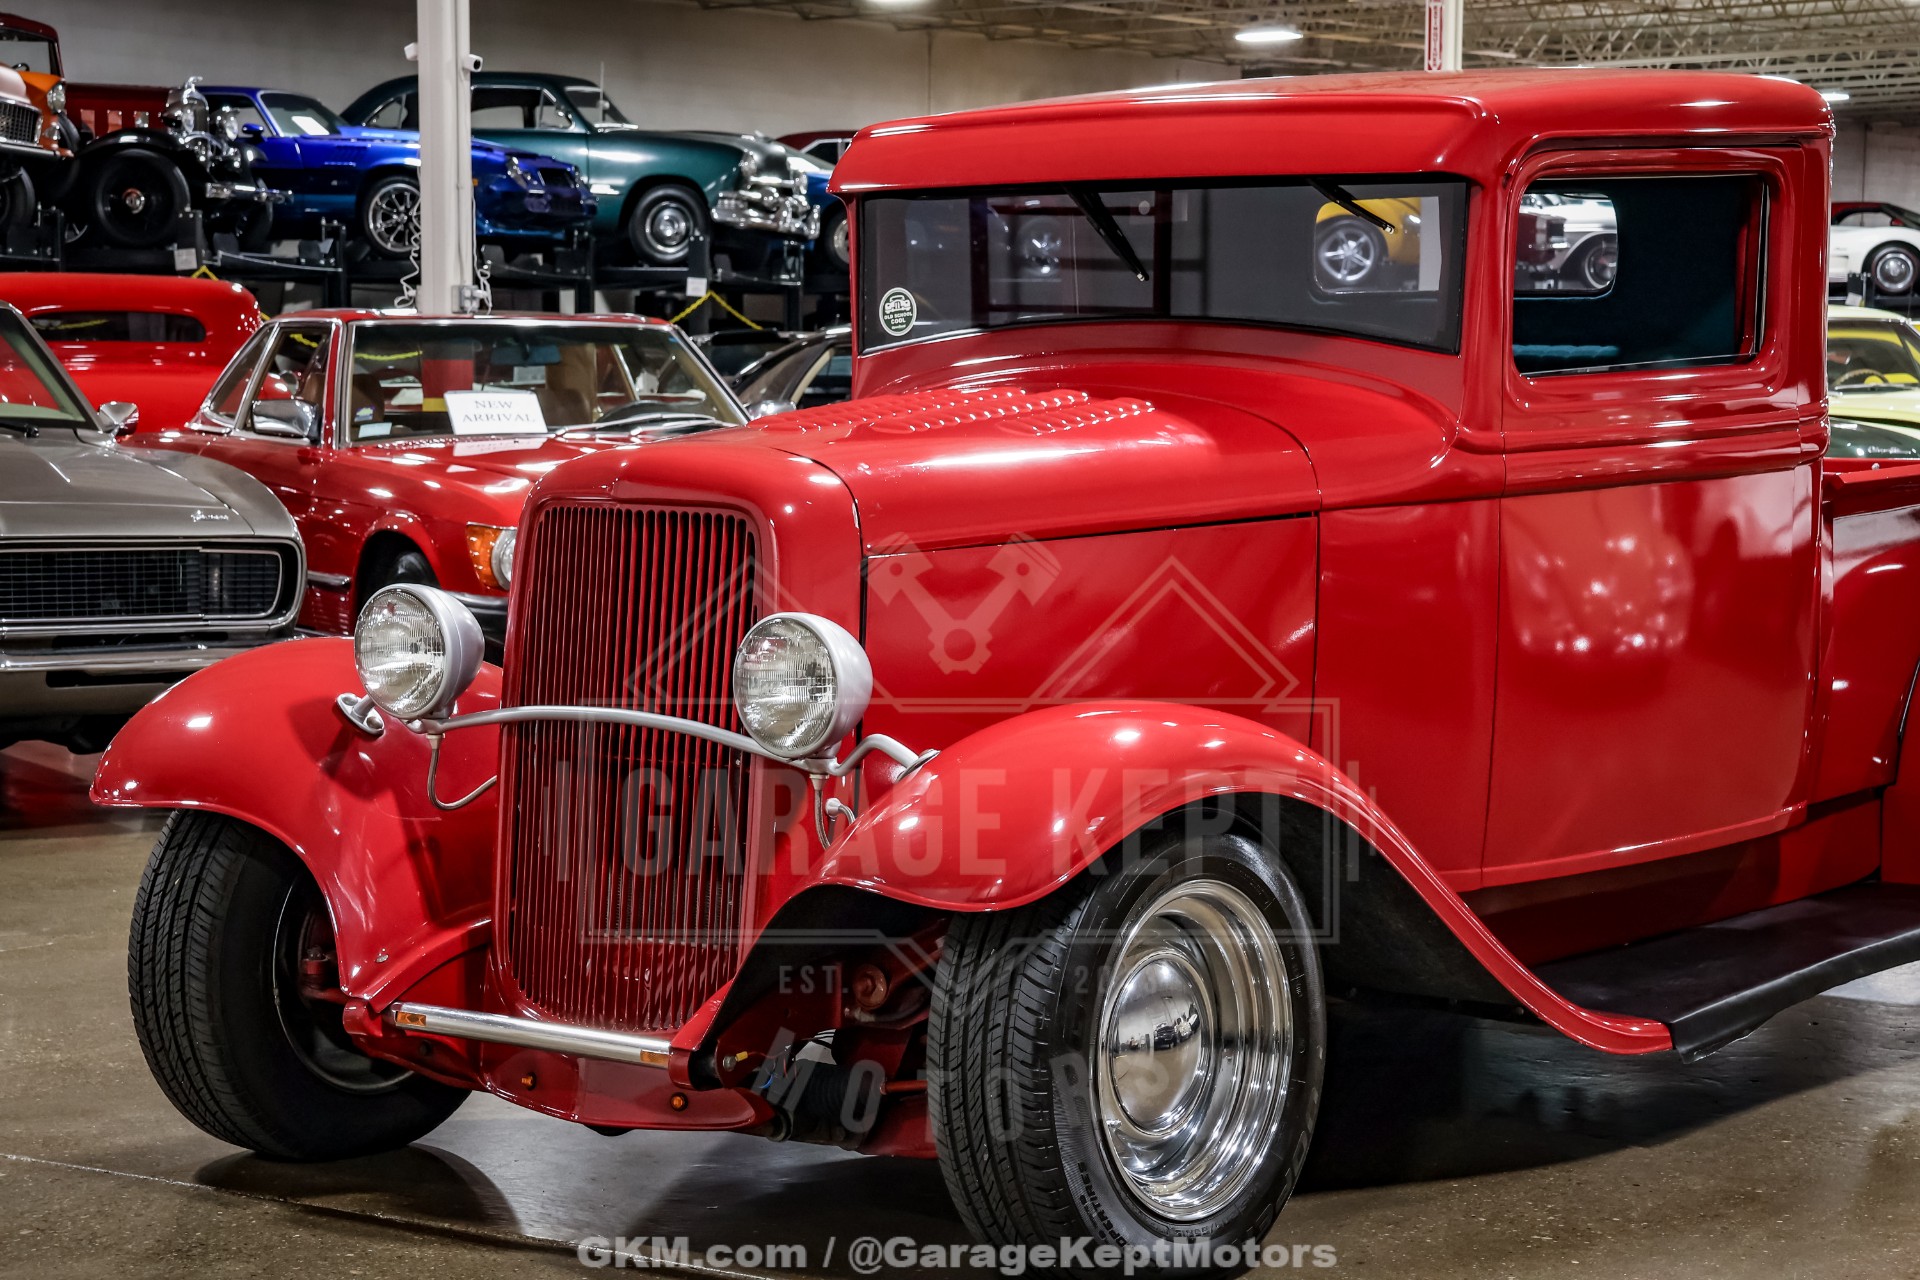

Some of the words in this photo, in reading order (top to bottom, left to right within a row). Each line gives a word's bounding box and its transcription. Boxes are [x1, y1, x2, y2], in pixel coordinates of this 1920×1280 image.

[894, 311, 912, 319] SCHOOL
[890, 317, 906, 325] COOL
[475, 400, 513, 409] NEW
[462, 413, 536, 423] ARRIVAL
